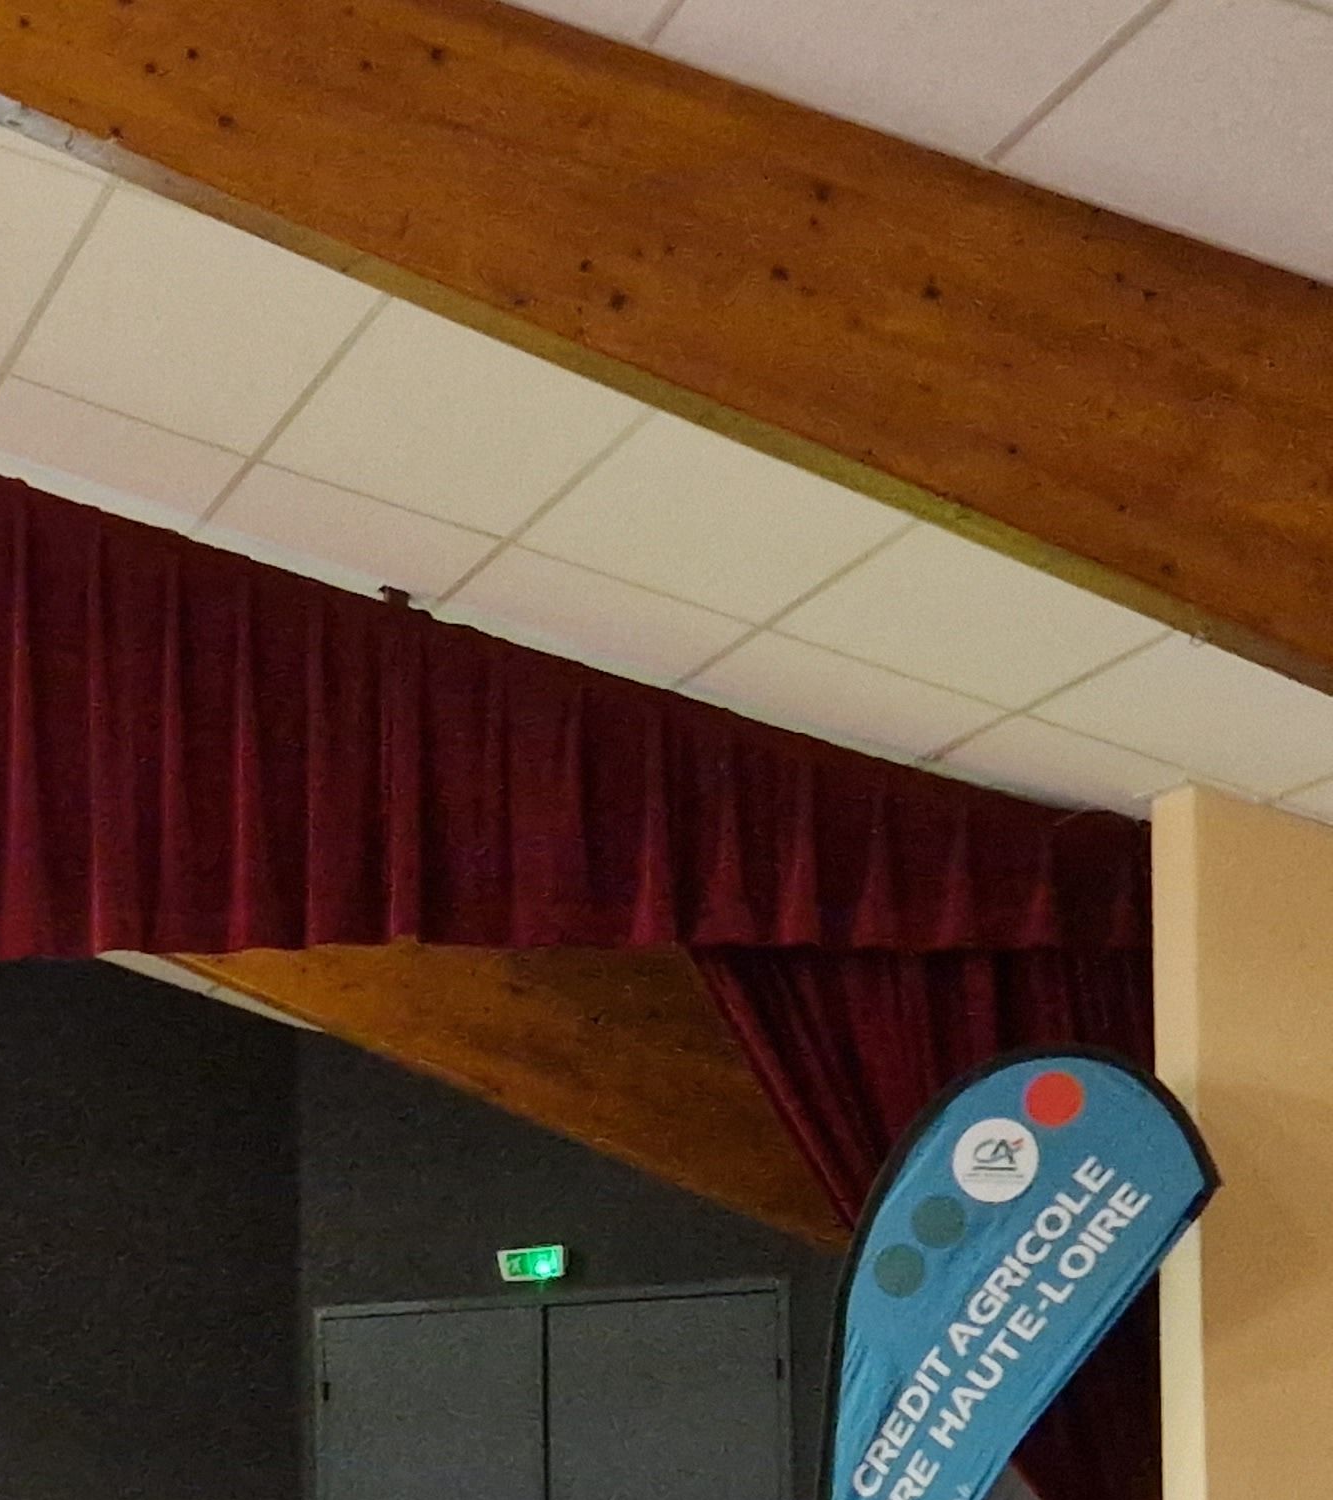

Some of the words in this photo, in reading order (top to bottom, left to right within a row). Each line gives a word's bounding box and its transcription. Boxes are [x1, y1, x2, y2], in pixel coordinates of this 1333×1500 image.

[851, 1345, 954, 1499] CREDIT
[946, 1156, 1115, 1355] AGRICOLE
[928, 1182, 1151, 1452] HAUTE-LOIRE
